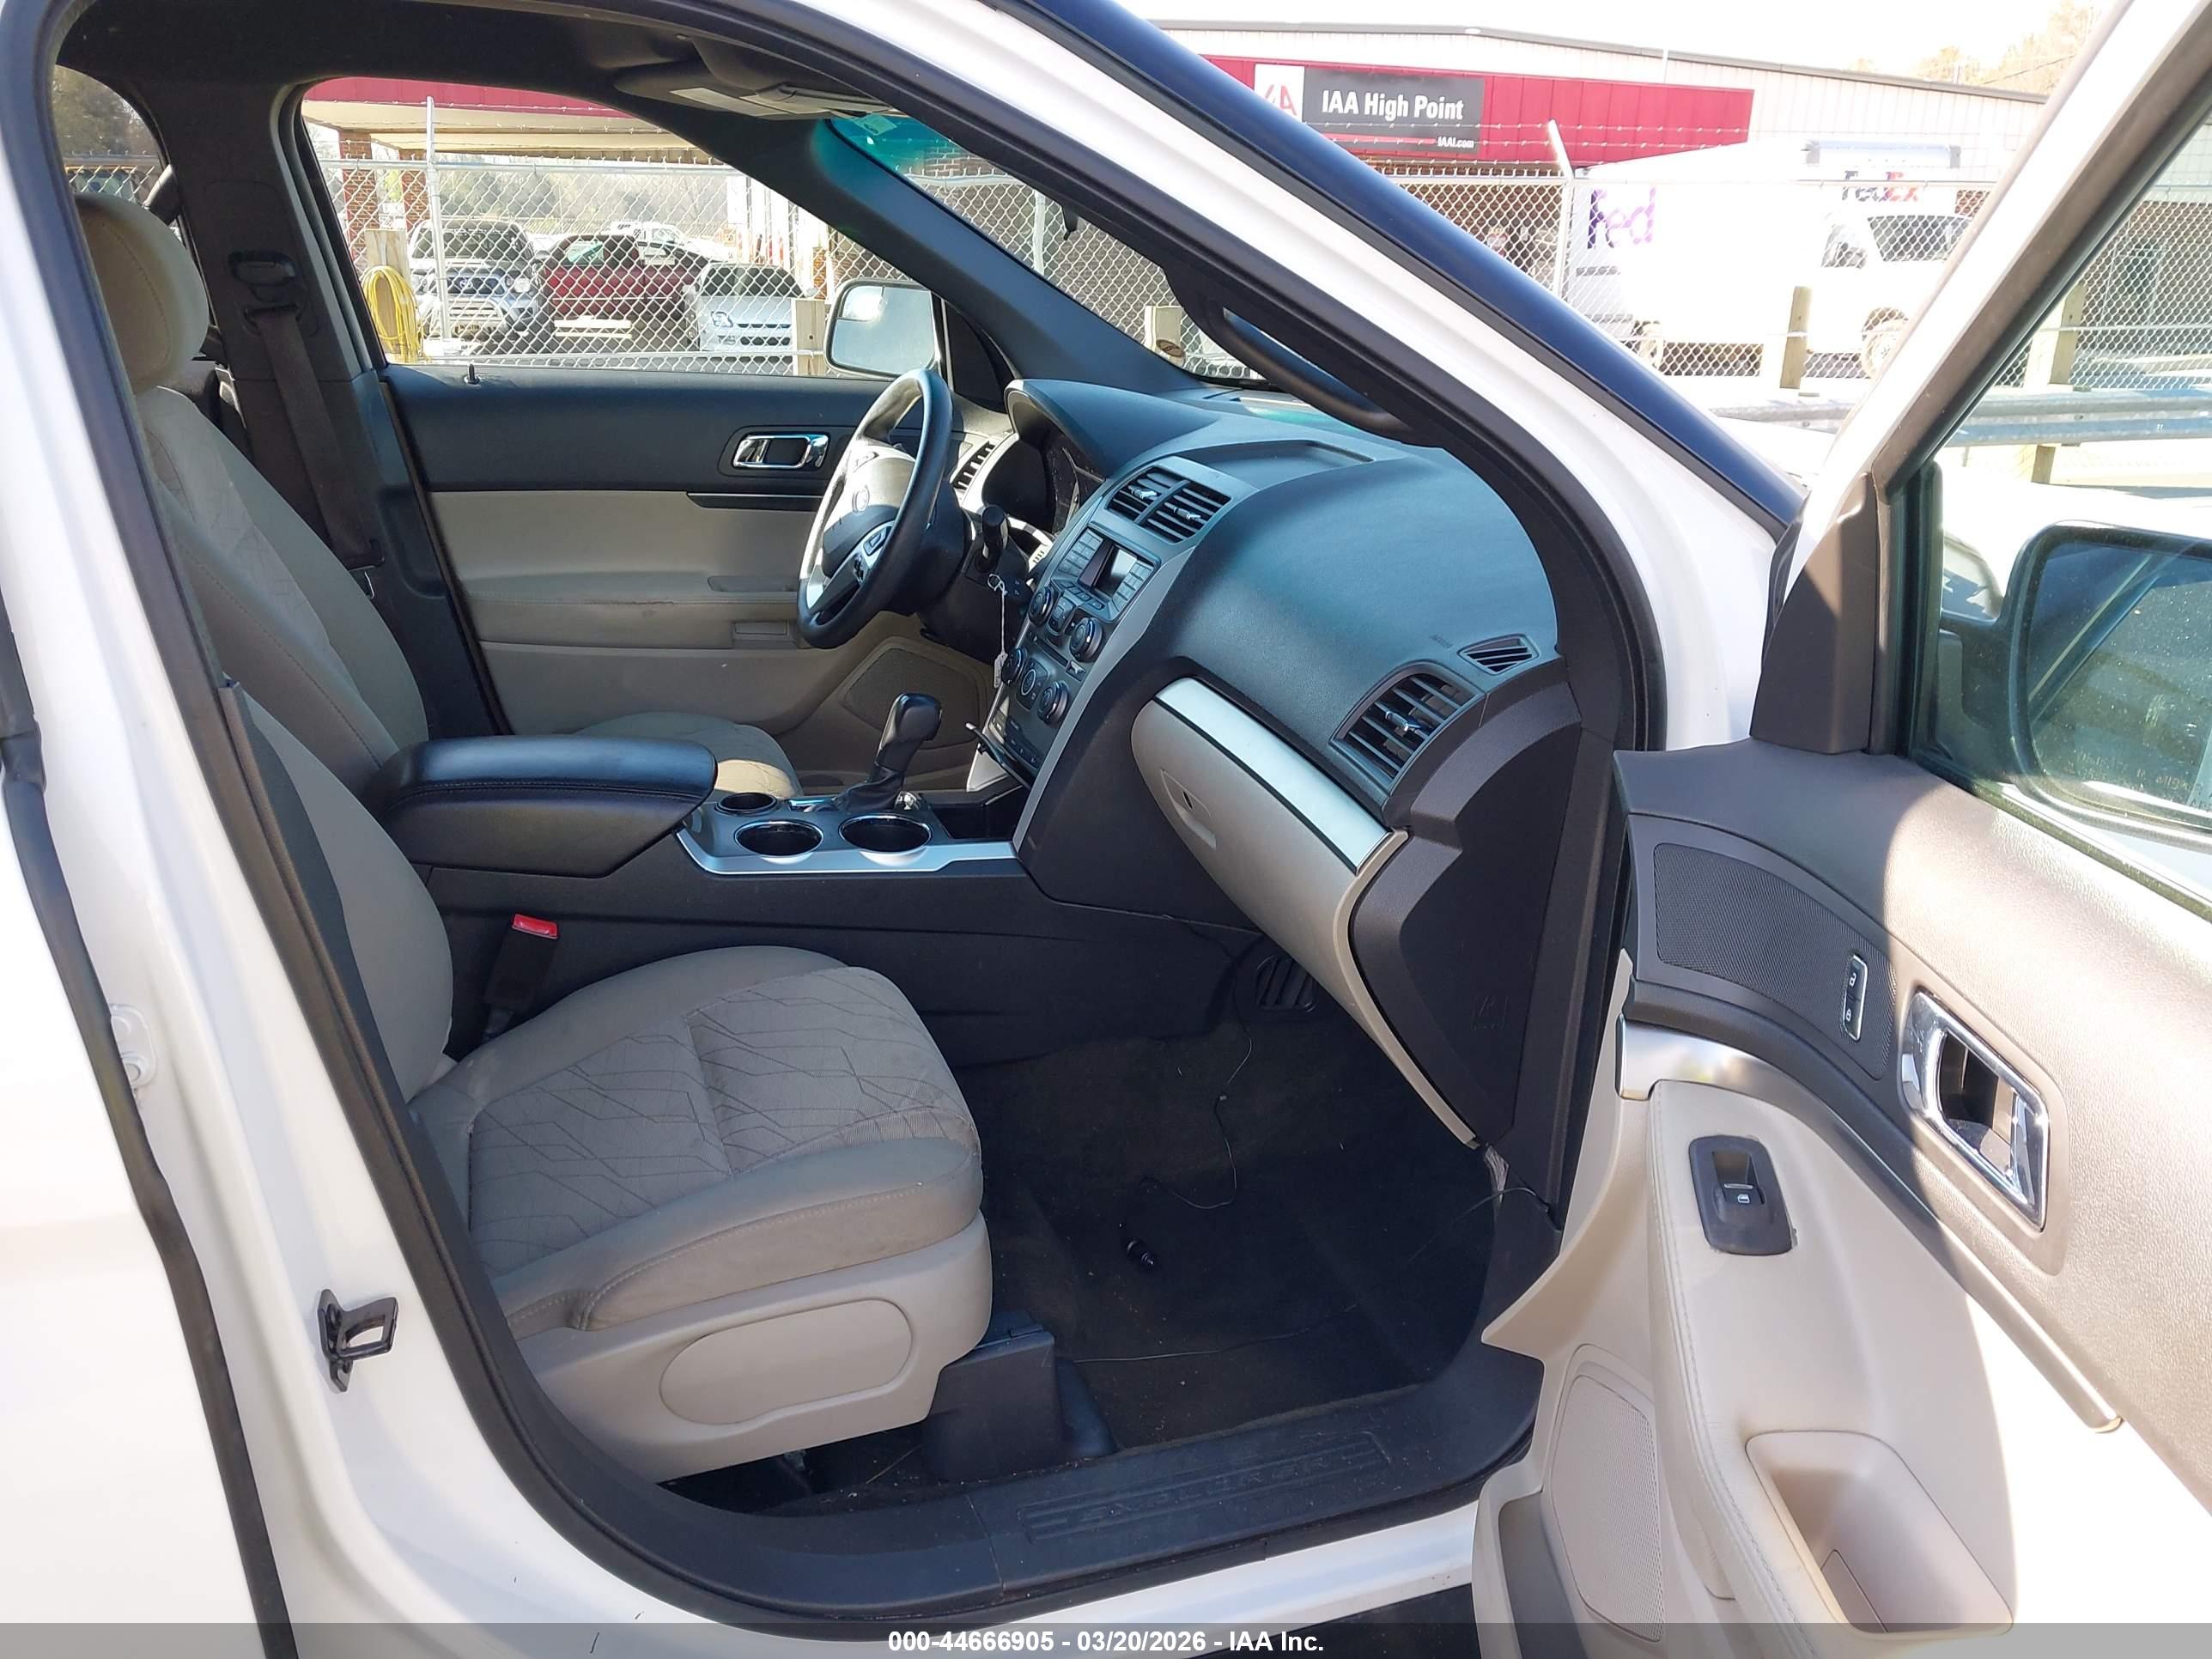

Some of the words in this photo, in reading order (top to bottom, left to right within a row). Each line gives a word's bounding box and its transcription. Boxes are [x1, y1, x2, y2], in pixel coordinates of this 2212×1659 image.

[1322, 89, 1359, 115] IAA
[1364, 92, 1408, 122] High
[1414, 94, 1463, 120] Point
[1437, 136, 1474, 149] IAAI.com
